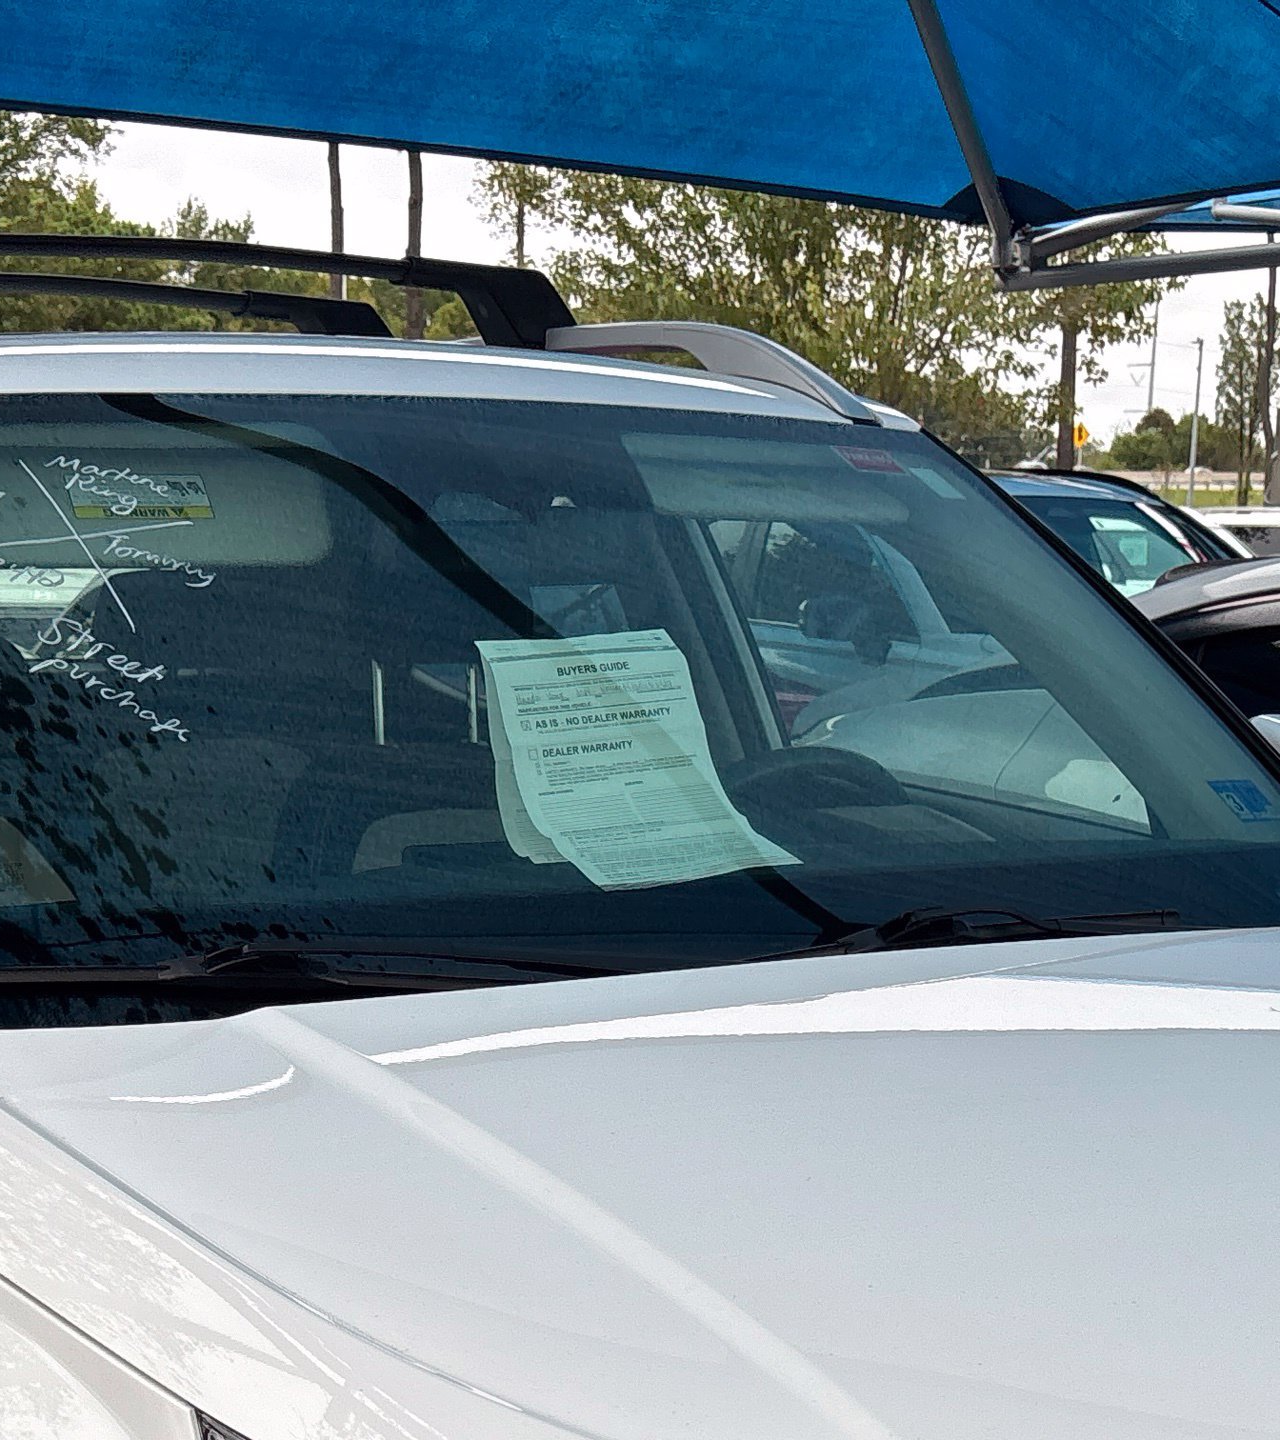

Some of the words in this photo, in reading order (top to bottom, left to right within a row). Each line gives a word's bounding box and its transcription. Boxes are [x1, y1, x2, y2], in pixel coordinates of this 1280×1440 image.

[37, 617, 165, 683] Street
[556, 662, 598, 677] BUYERS
[599, 661, 630, 673] GUIDE
[535, 719, 548, 730] AS
[549, 718, 559, 729] IS
[565, 715, 580, 727] NO
[581, 712, 618, 726] DEALER
[618, 706, 671, 721] WARRANTY
[542, 745, 579, 758] DEALER
[580, 740, 634, 755] WARRANTY
